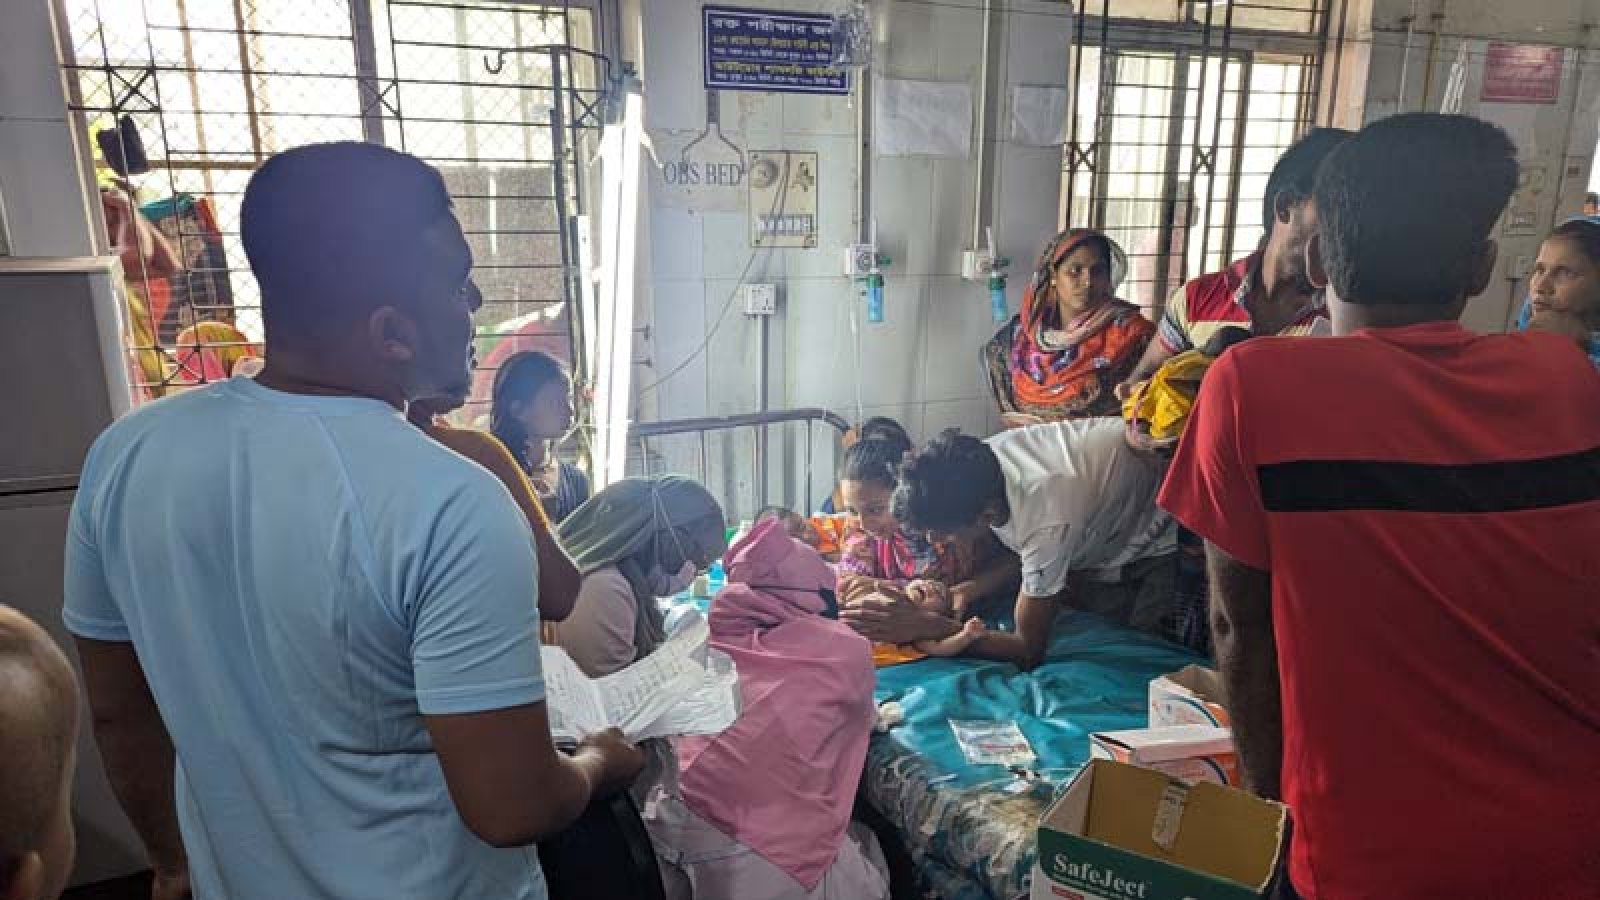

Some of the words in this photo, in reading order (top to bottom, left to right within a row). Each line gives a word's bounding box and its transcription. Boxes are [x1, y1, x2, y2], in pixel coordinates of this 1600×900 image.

[663, 161, 700, 185] OBS
[706, 162, 741, 186] BED
[1054, 854, 1145, 898] SafeJect
